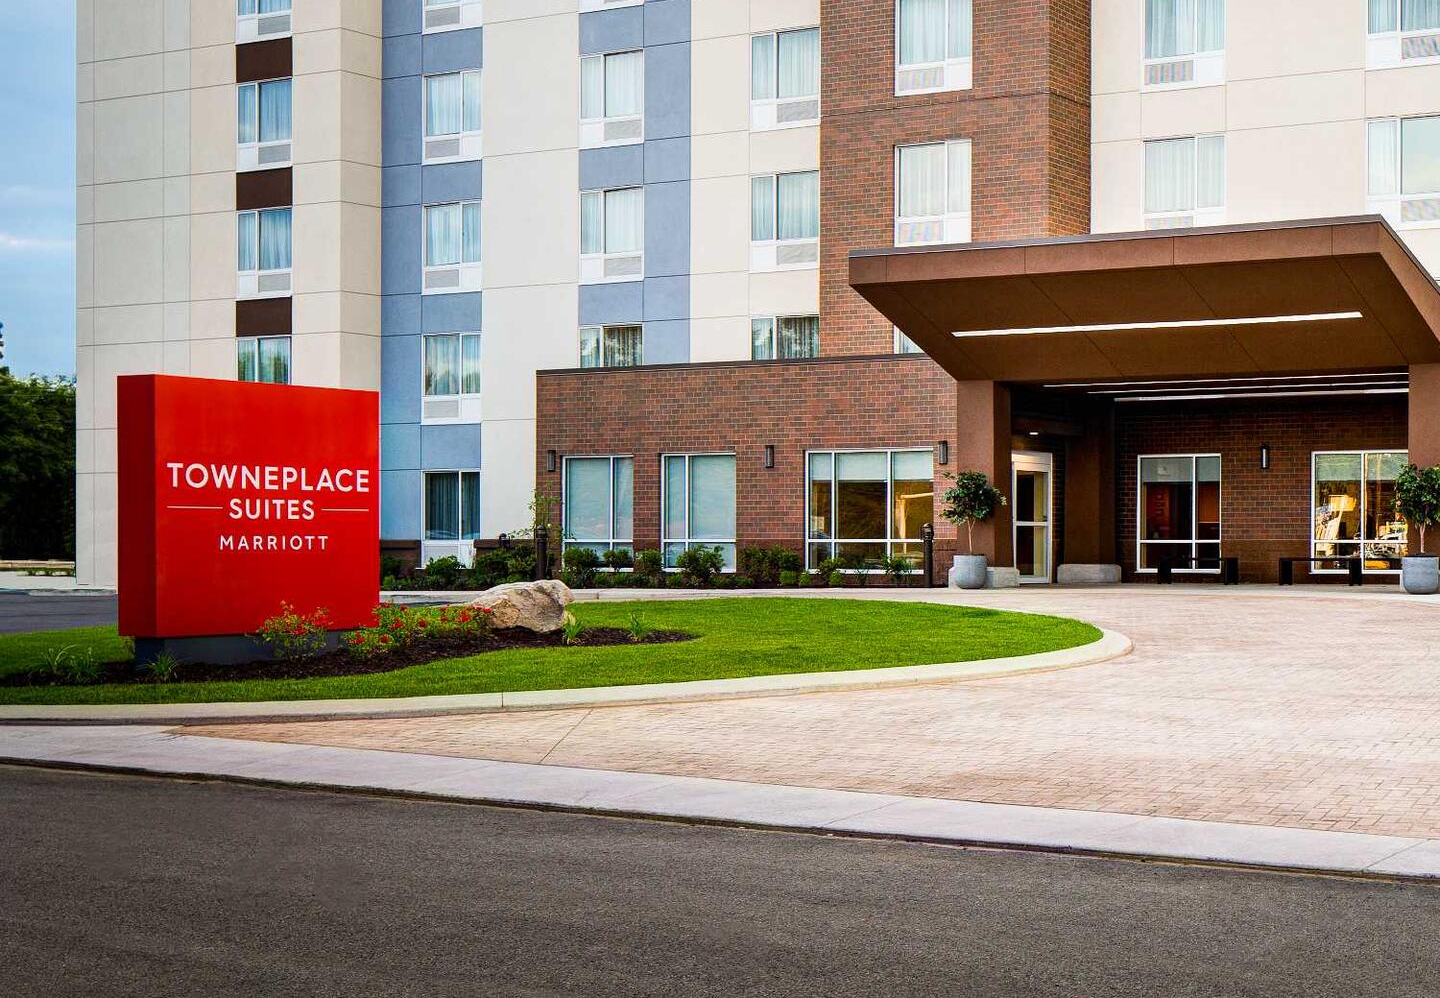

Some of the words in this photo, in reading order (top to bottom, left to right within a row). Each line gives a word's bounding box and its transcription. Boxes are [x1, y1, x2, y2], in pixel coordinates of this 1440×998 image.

[166, 462, 369, 492] TOWNEPLACE
[229, 498, 315, 520] SUITES
[219, 534, 328, 551] MARRIOTT
